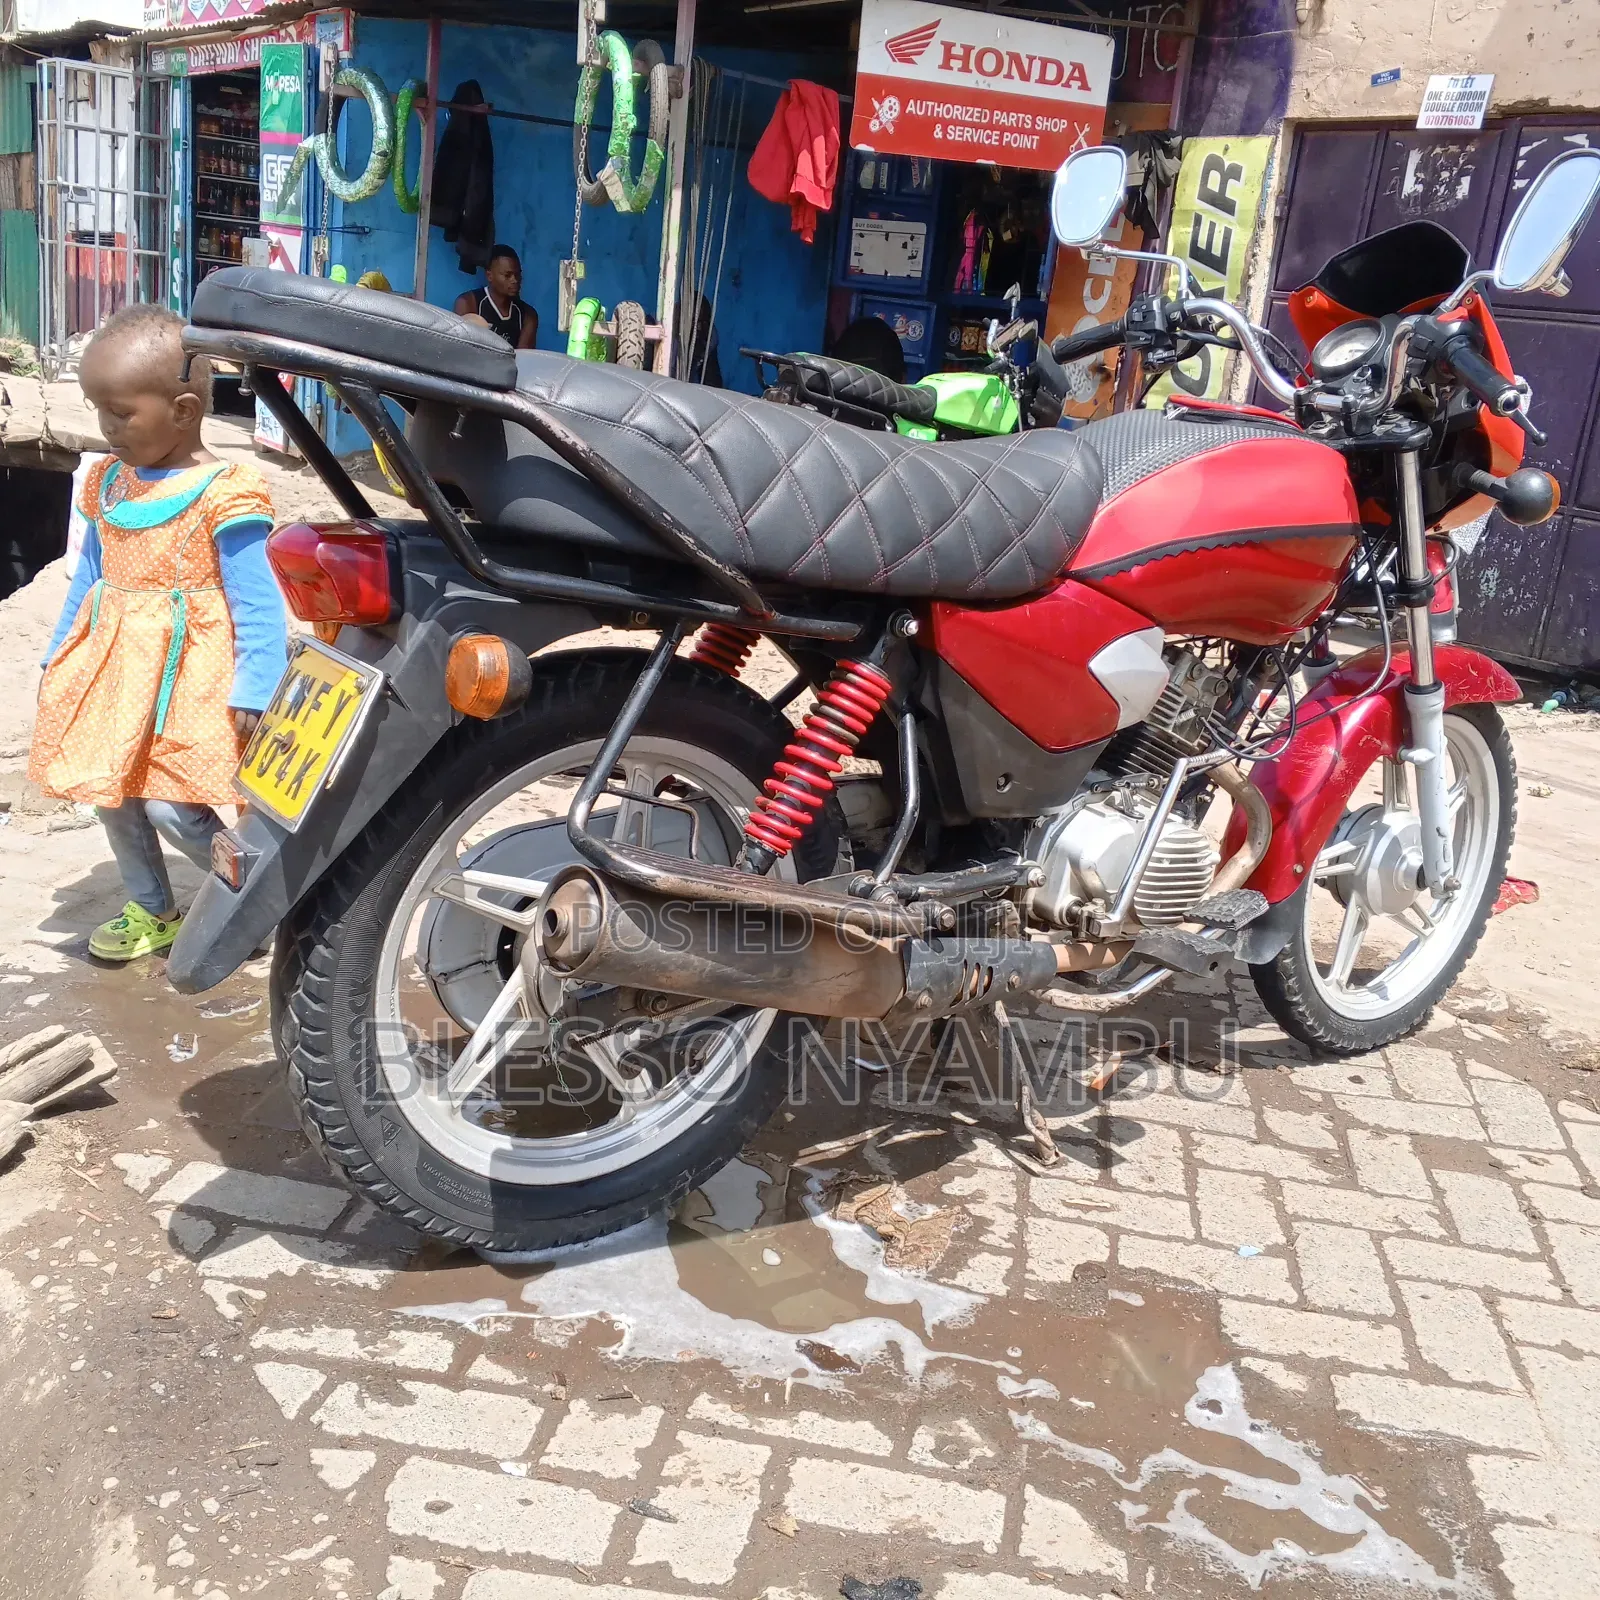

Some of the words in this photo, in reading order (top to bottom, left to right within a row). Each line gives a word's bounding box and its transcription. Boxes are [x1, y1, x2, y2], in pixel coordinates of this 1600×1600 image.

[144, 8, 166, 21] EQUITY
[188, 40, 241, 68] GATEWAY
[937, 39, 1092, 92] HONDA
[1460, 76, 1476, 88] LET
[1426, 91, 1443, 101] ONE
[1444, 91, 1487, 101] BEDROOM
[1424, 102, 1456, 112] DOUBLE
[1456, 102, 1484, 112] ROOM
[905, 98, 990, 124] AUTHORIZED
[992, 110, 1033, 129] PARTS
[1034, 116, 1068, 133] SHOP
[933, 123, 943, 139] &
[946, 125, 1000, 146] SERVICE
[1002, 131, 1040, 150] POINT
[263, 189, 296, 205] BAK
